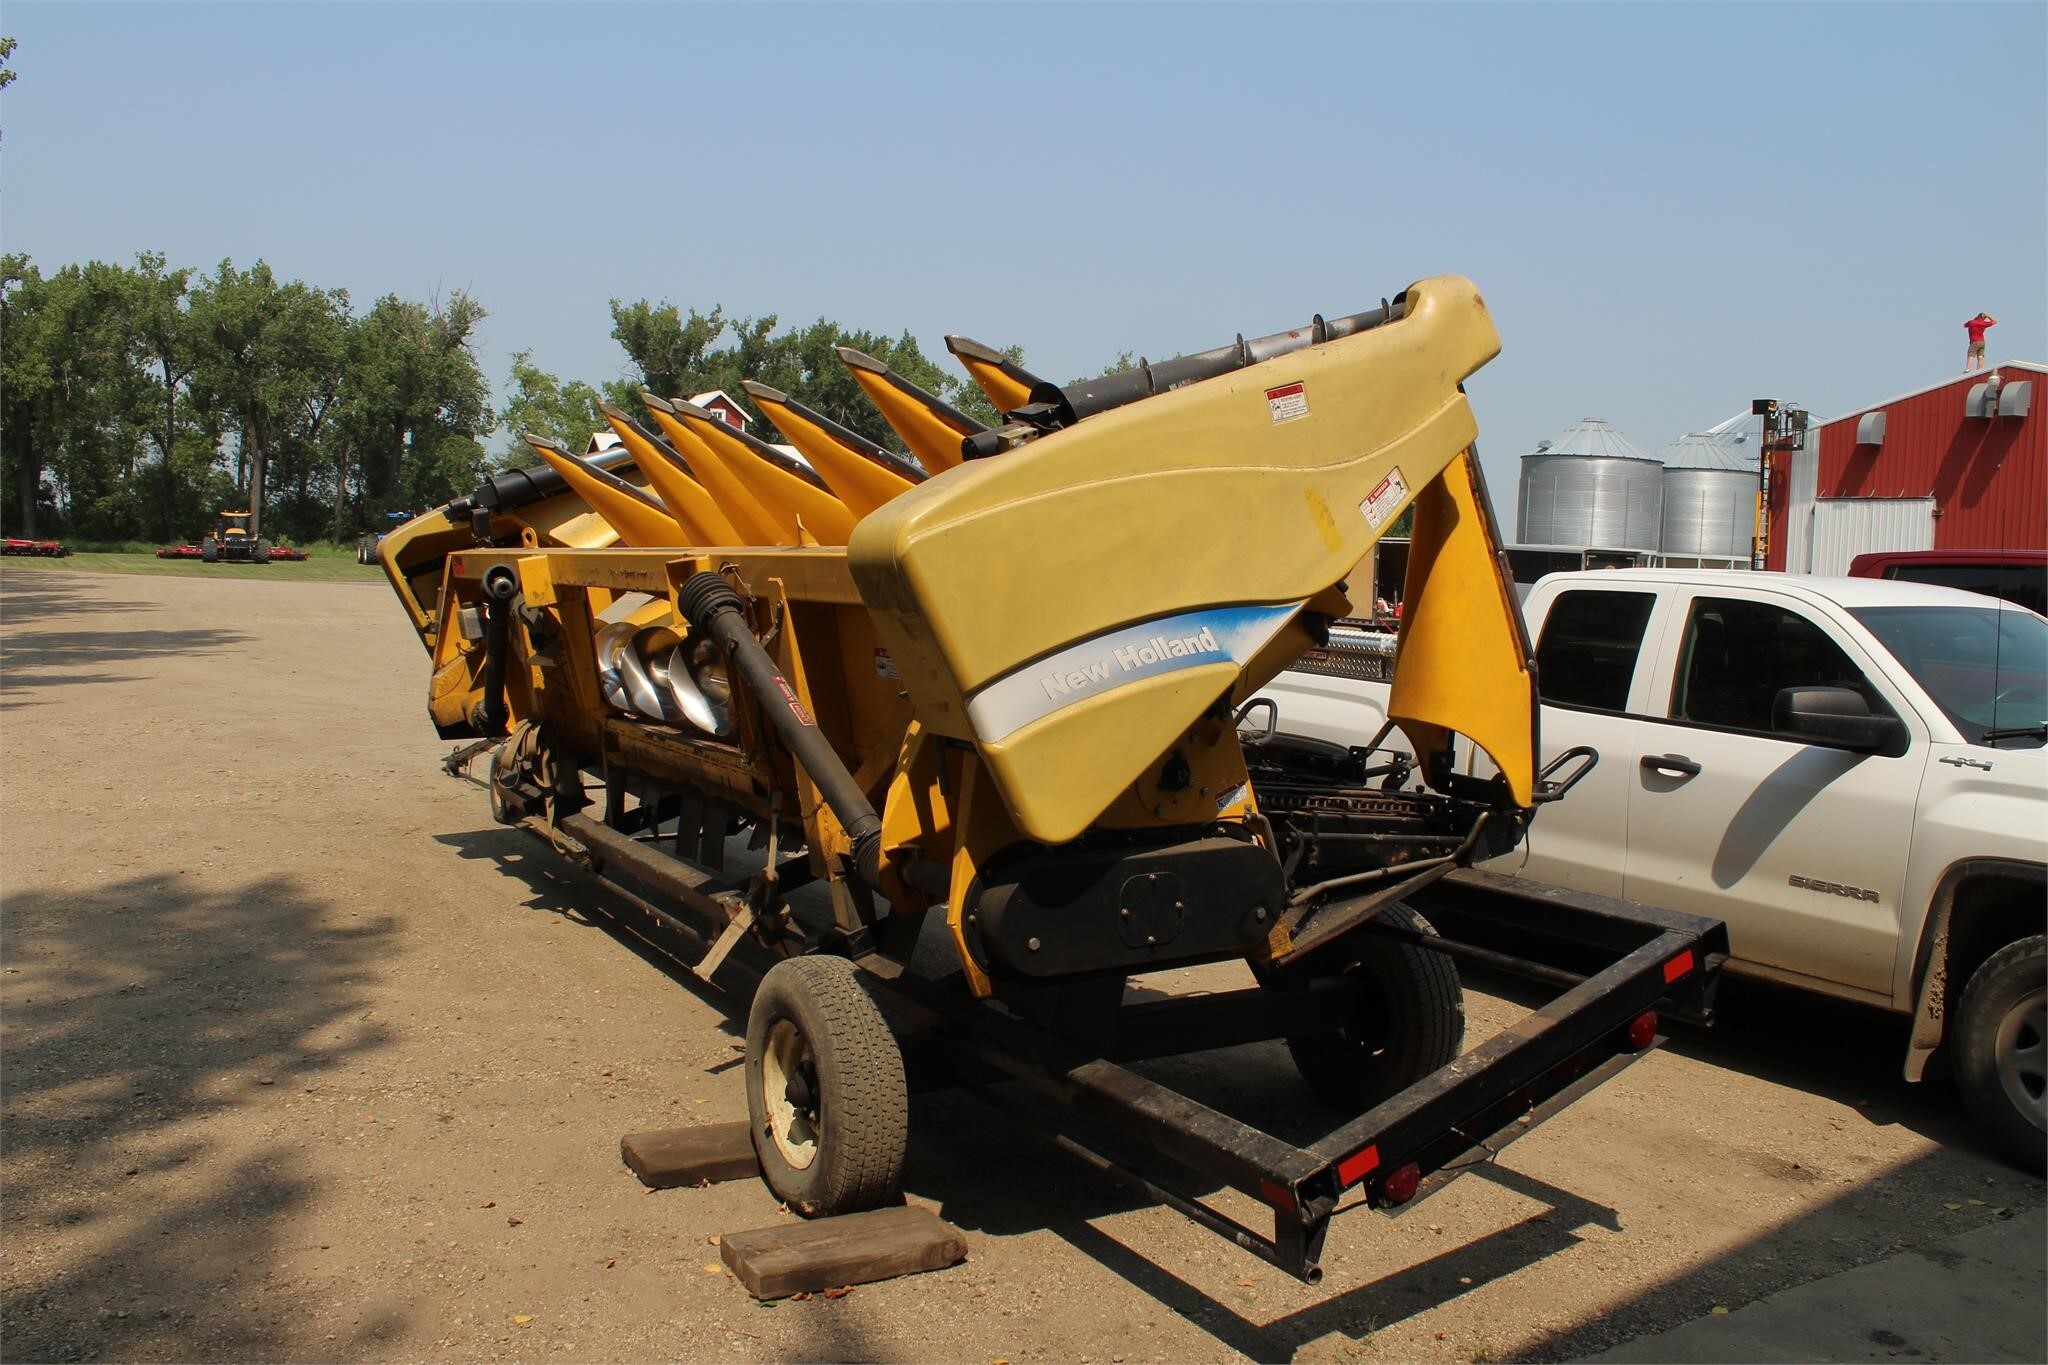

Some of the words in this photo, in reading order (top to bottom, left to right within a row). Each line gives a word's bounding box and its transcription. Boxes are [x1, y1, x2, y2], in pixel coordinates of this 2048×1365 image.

[1040, 660, 1110, 700] New
[1112, 626, 1219, 672] Holland
[1789, 874, 1880, 904] SIERRA
